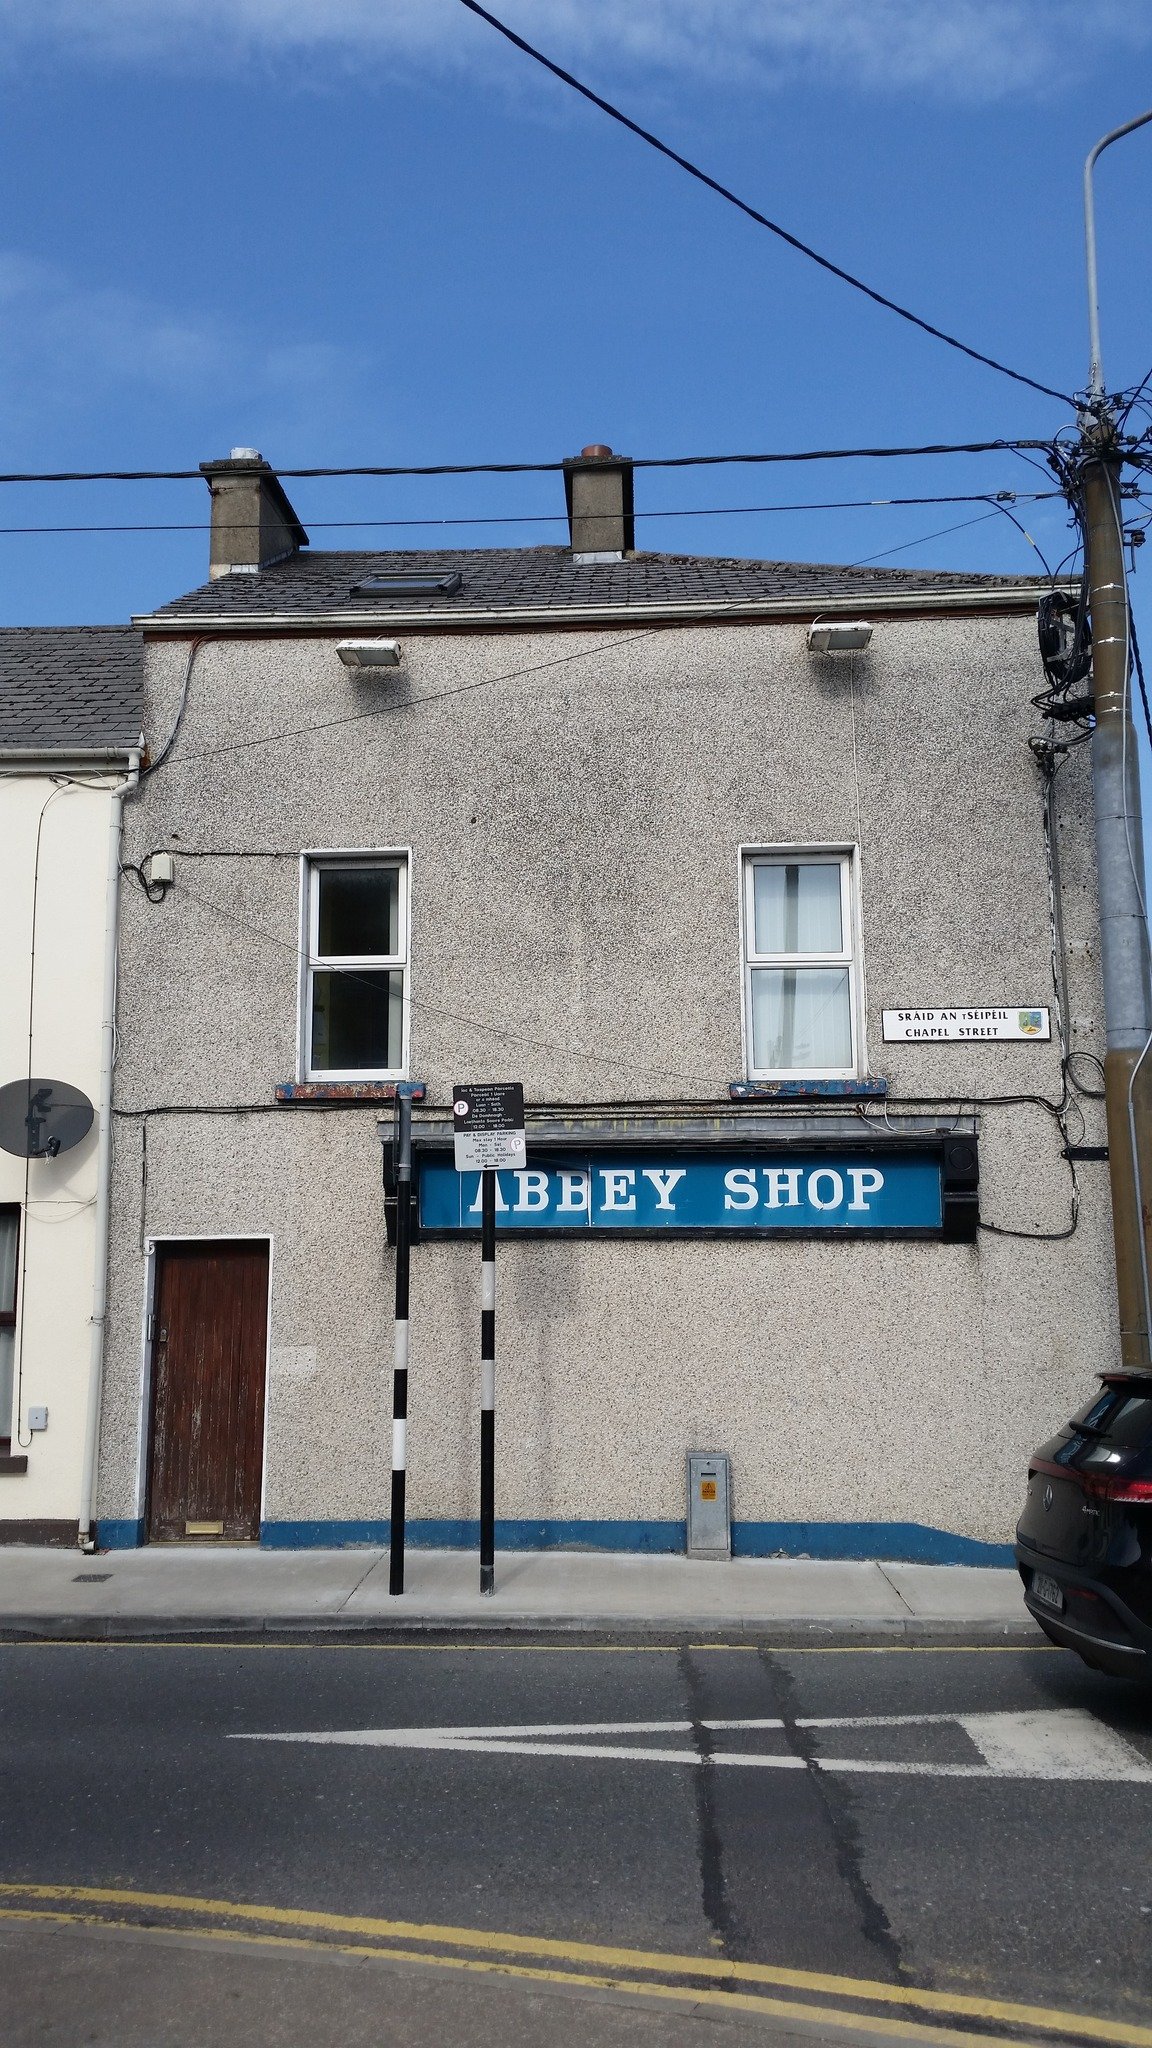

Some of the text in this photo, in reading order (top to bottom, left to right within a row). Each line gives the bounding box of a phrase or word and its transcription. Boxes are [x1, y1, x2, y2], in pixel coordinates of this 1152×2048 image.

[898, 1011, 934, 1021] SRÁID
[940, 1012, 957, 1020] AN
[905, 1027, 998, 1037] CHAPEL STREET
[457, 1104, 464, 1112] P
[514, 1140, 520, 1149] P
[469, 1168, 884, 1212] ABBEY SHOP
